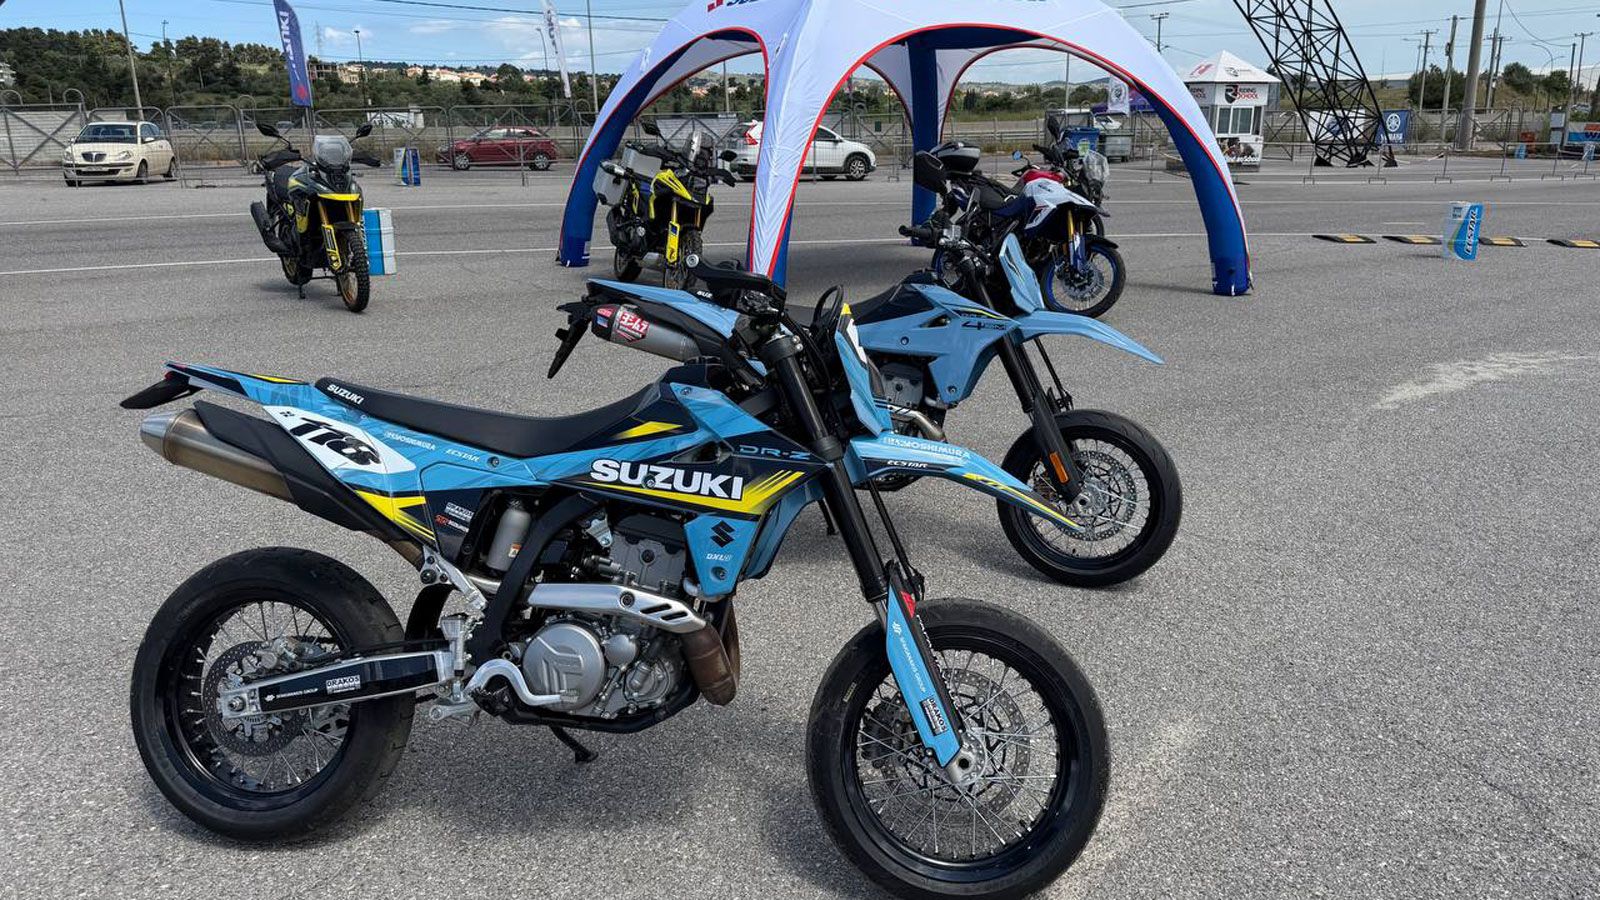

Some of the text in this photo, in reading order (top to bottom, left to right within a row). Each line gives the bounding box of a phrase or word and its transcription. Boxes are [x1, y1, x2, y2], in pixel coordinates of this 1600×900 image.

[327, 384, 365, 405] SUZUKI
[739, 445, 811, 461] DR-Z
[902, 440, 971, 460] YOSHIMURA
[590, 459, 743, 501] SUZUKI
[929, 697, 948, 732] DRAKOS
